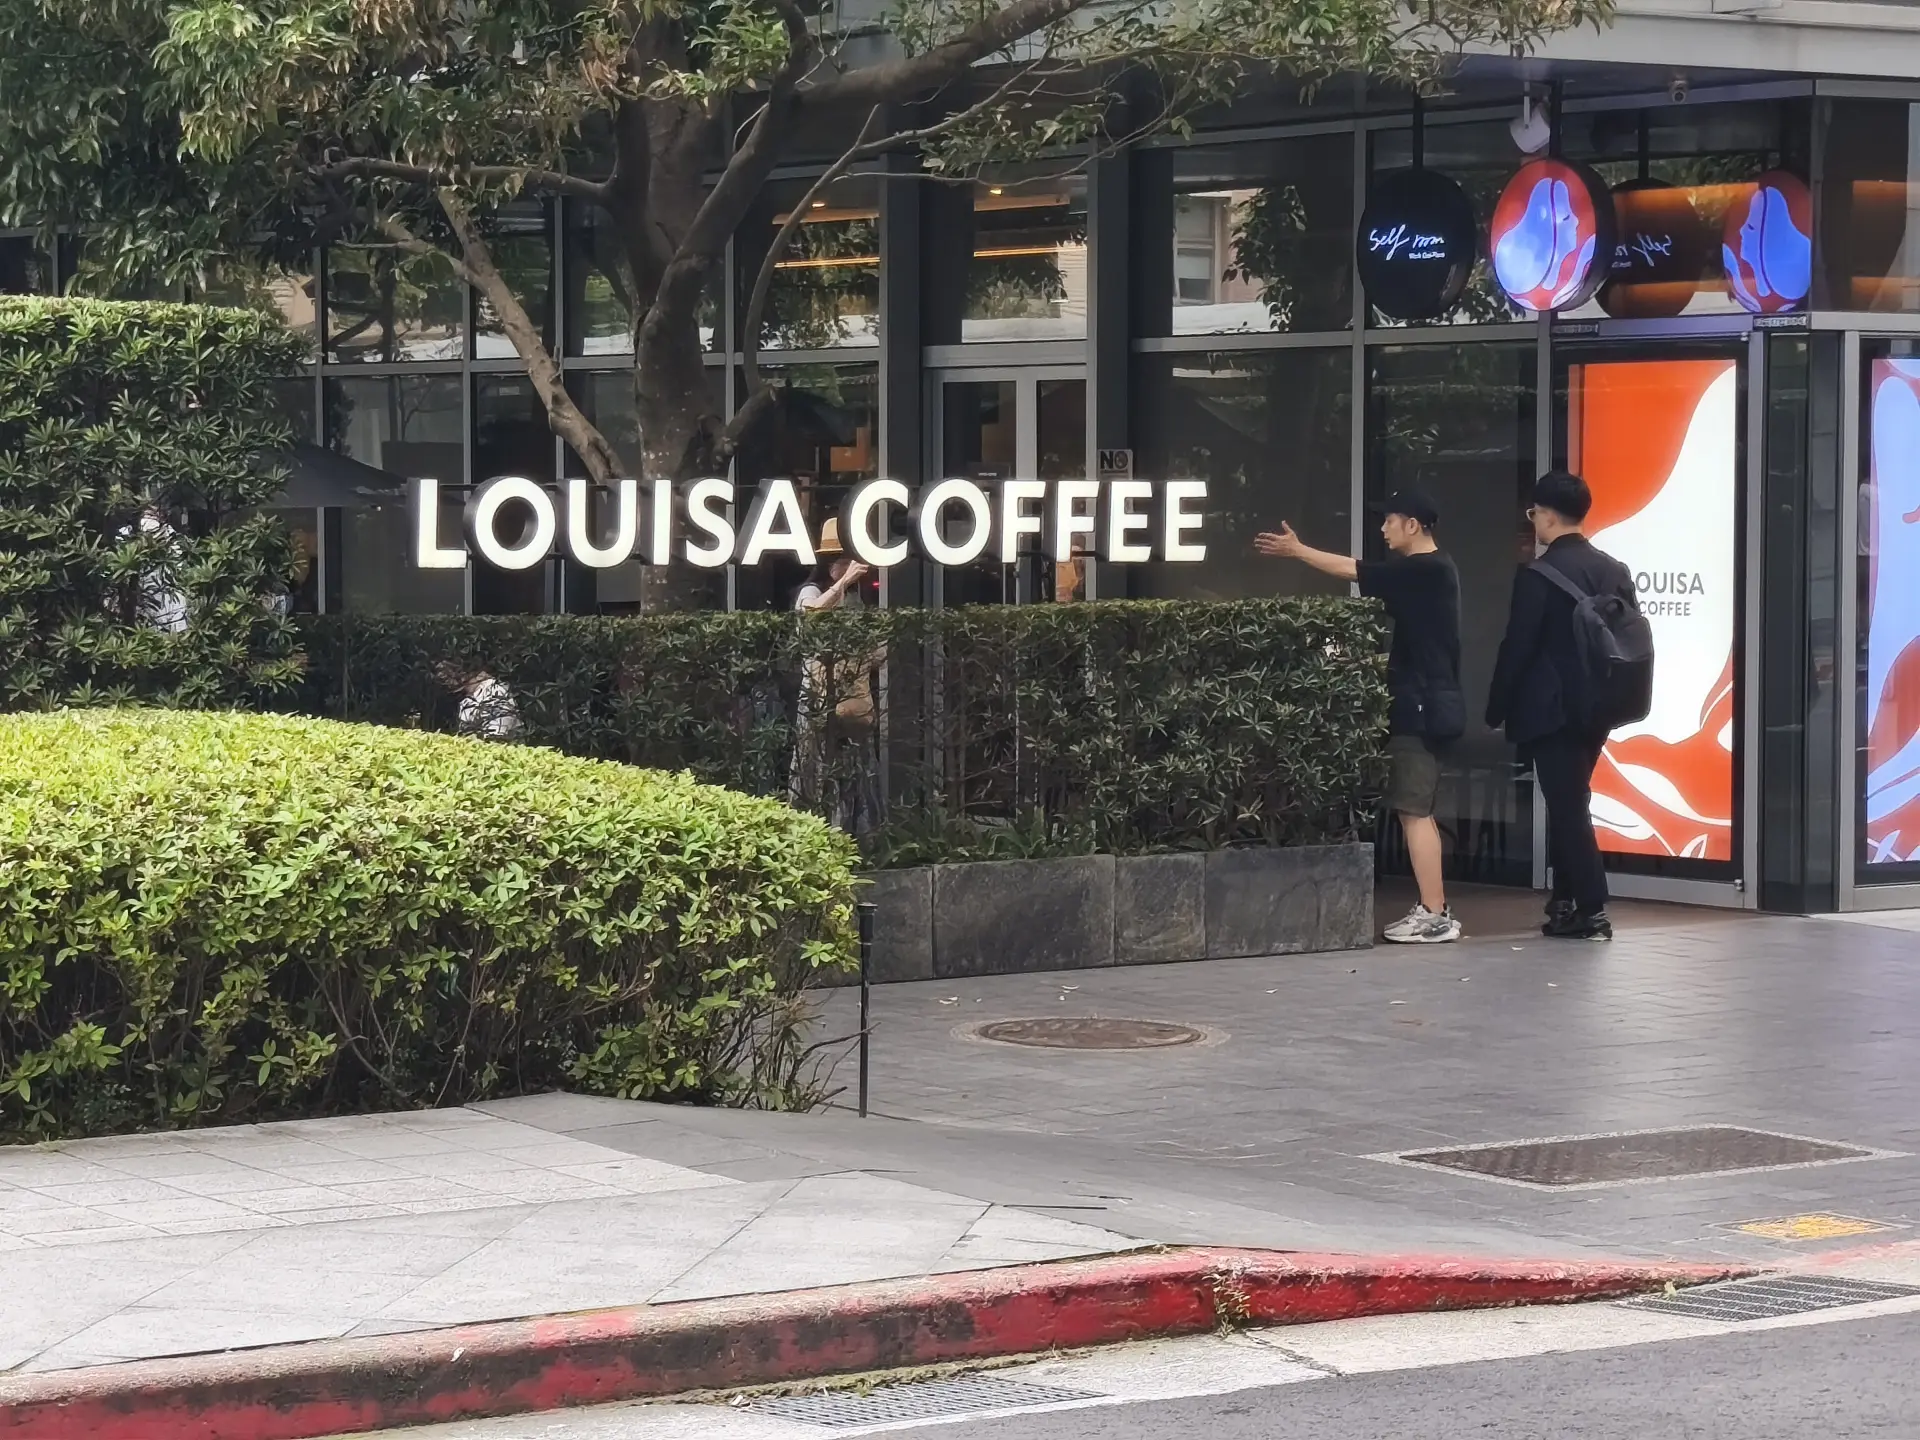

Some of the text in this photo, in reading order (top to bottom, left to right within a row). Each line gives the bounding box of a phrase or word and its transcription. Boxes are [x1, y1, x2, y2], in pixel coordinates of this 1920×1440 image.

[1369, 224, 1410, 261] Self
[415, 478, 1208, 570] LOUISA COFFEE
[1635, 571, 1704, 595] OUISA
[1639, 600, 1692, 616] COFFEE
